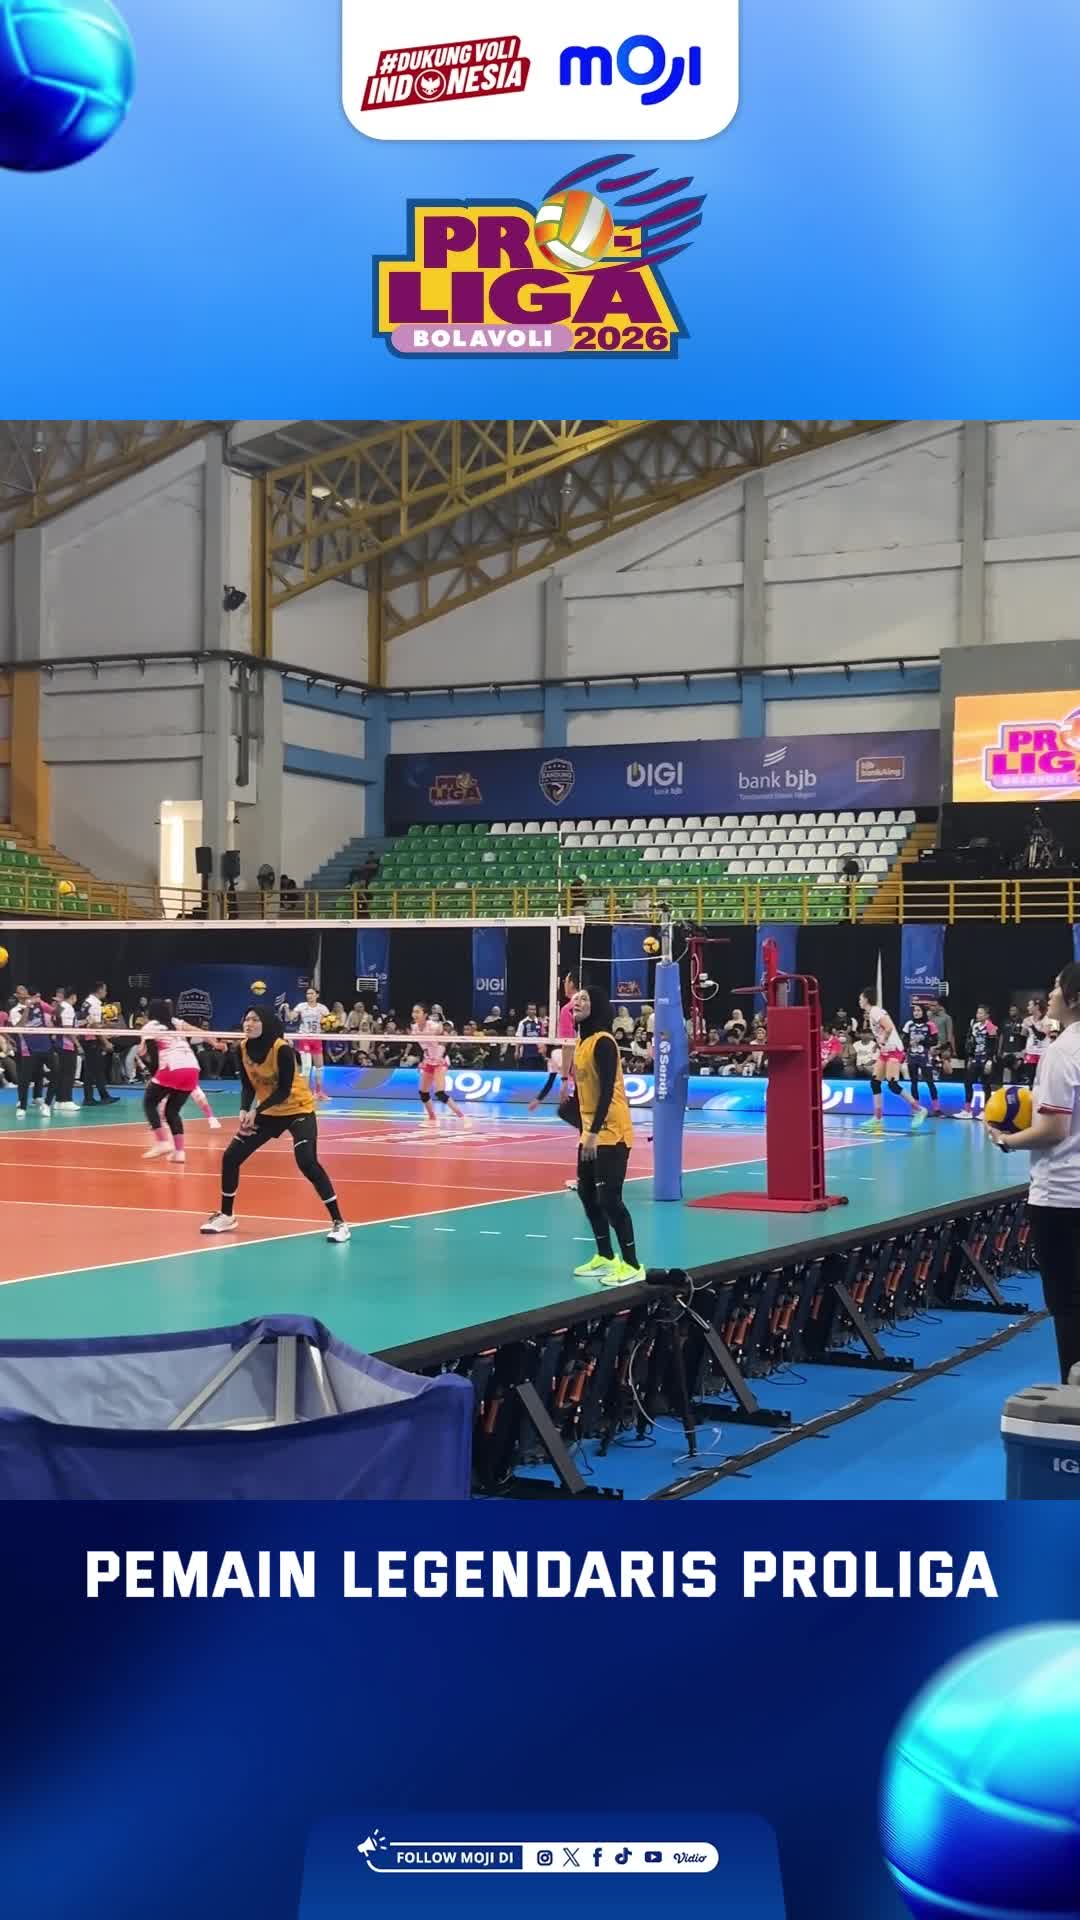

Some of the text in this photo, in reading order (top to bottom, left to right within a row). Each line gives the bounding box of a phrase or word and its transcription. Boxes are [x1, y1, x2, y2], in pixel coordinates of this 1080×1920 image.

[992, 750, 1080, 775] LIG
[626, 761, 683, 788] DIGI
[738, 769, 817, 791] bank bjb
[476, 978, 505, 991] DIGI
[925, 976, 941, 986] bjb
